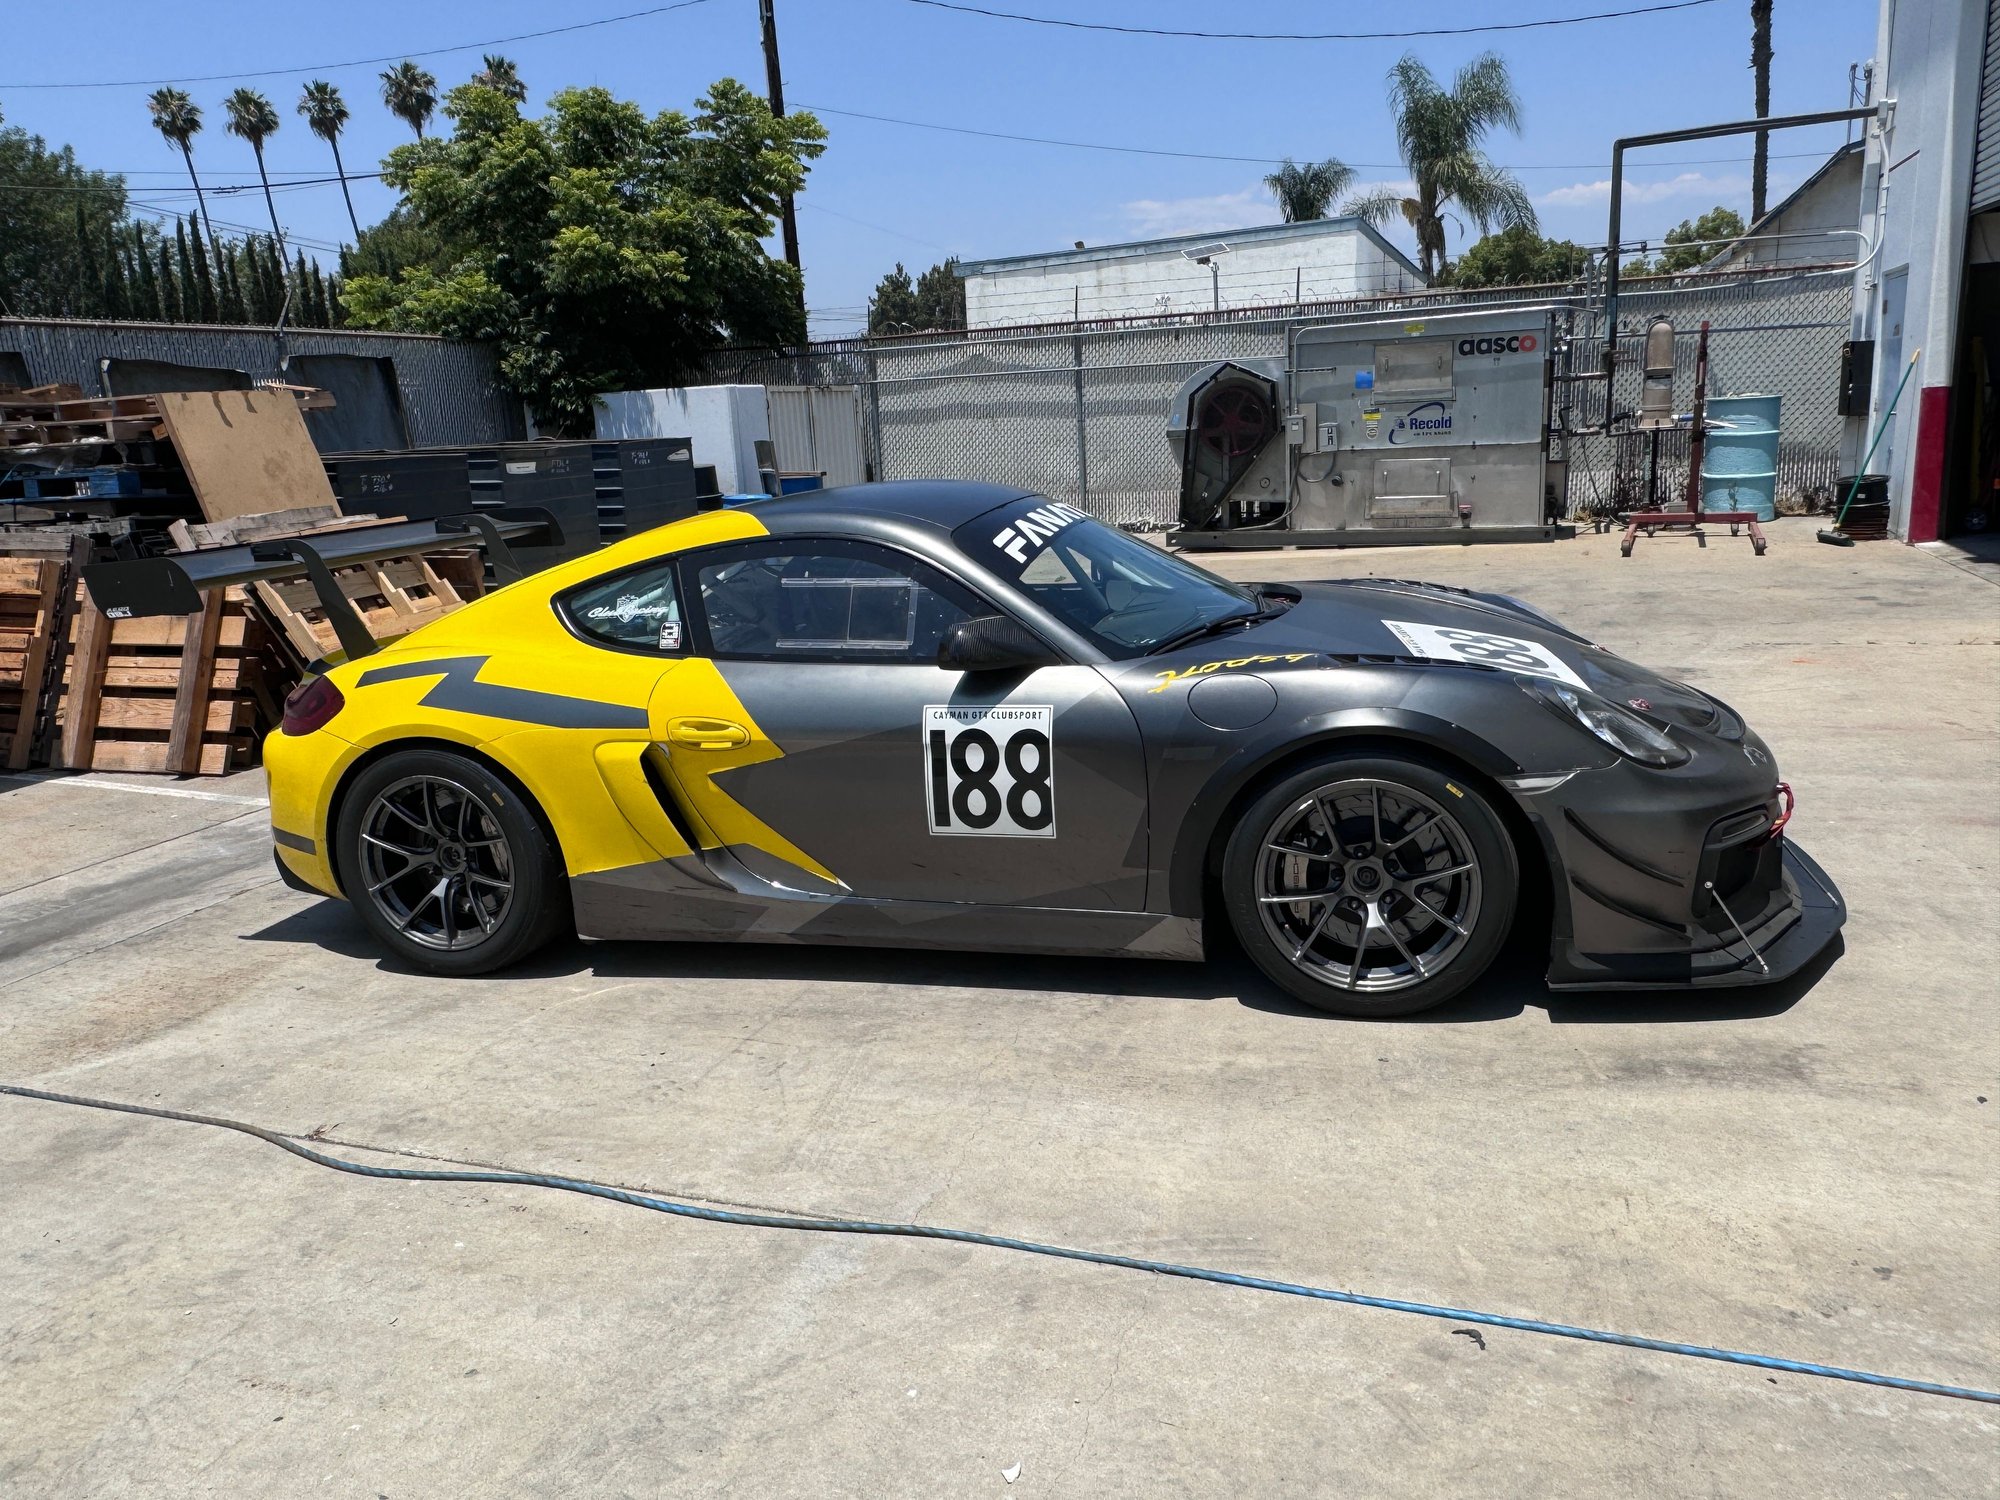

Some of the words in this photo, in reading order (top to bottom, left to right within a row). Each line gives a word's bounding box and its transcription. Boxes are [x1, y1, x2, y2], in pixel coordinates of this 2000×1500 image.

[1458, 335, 1537, 356] aasco
[1410, 416, 1452, 430] Recold
[933, 711, 969, 720] CAYMAN
[971, 711, 988, 720] GT4
[990, 711, 1043, 720] CLUBSPORT
[929, 728, 1053, 831] 188
